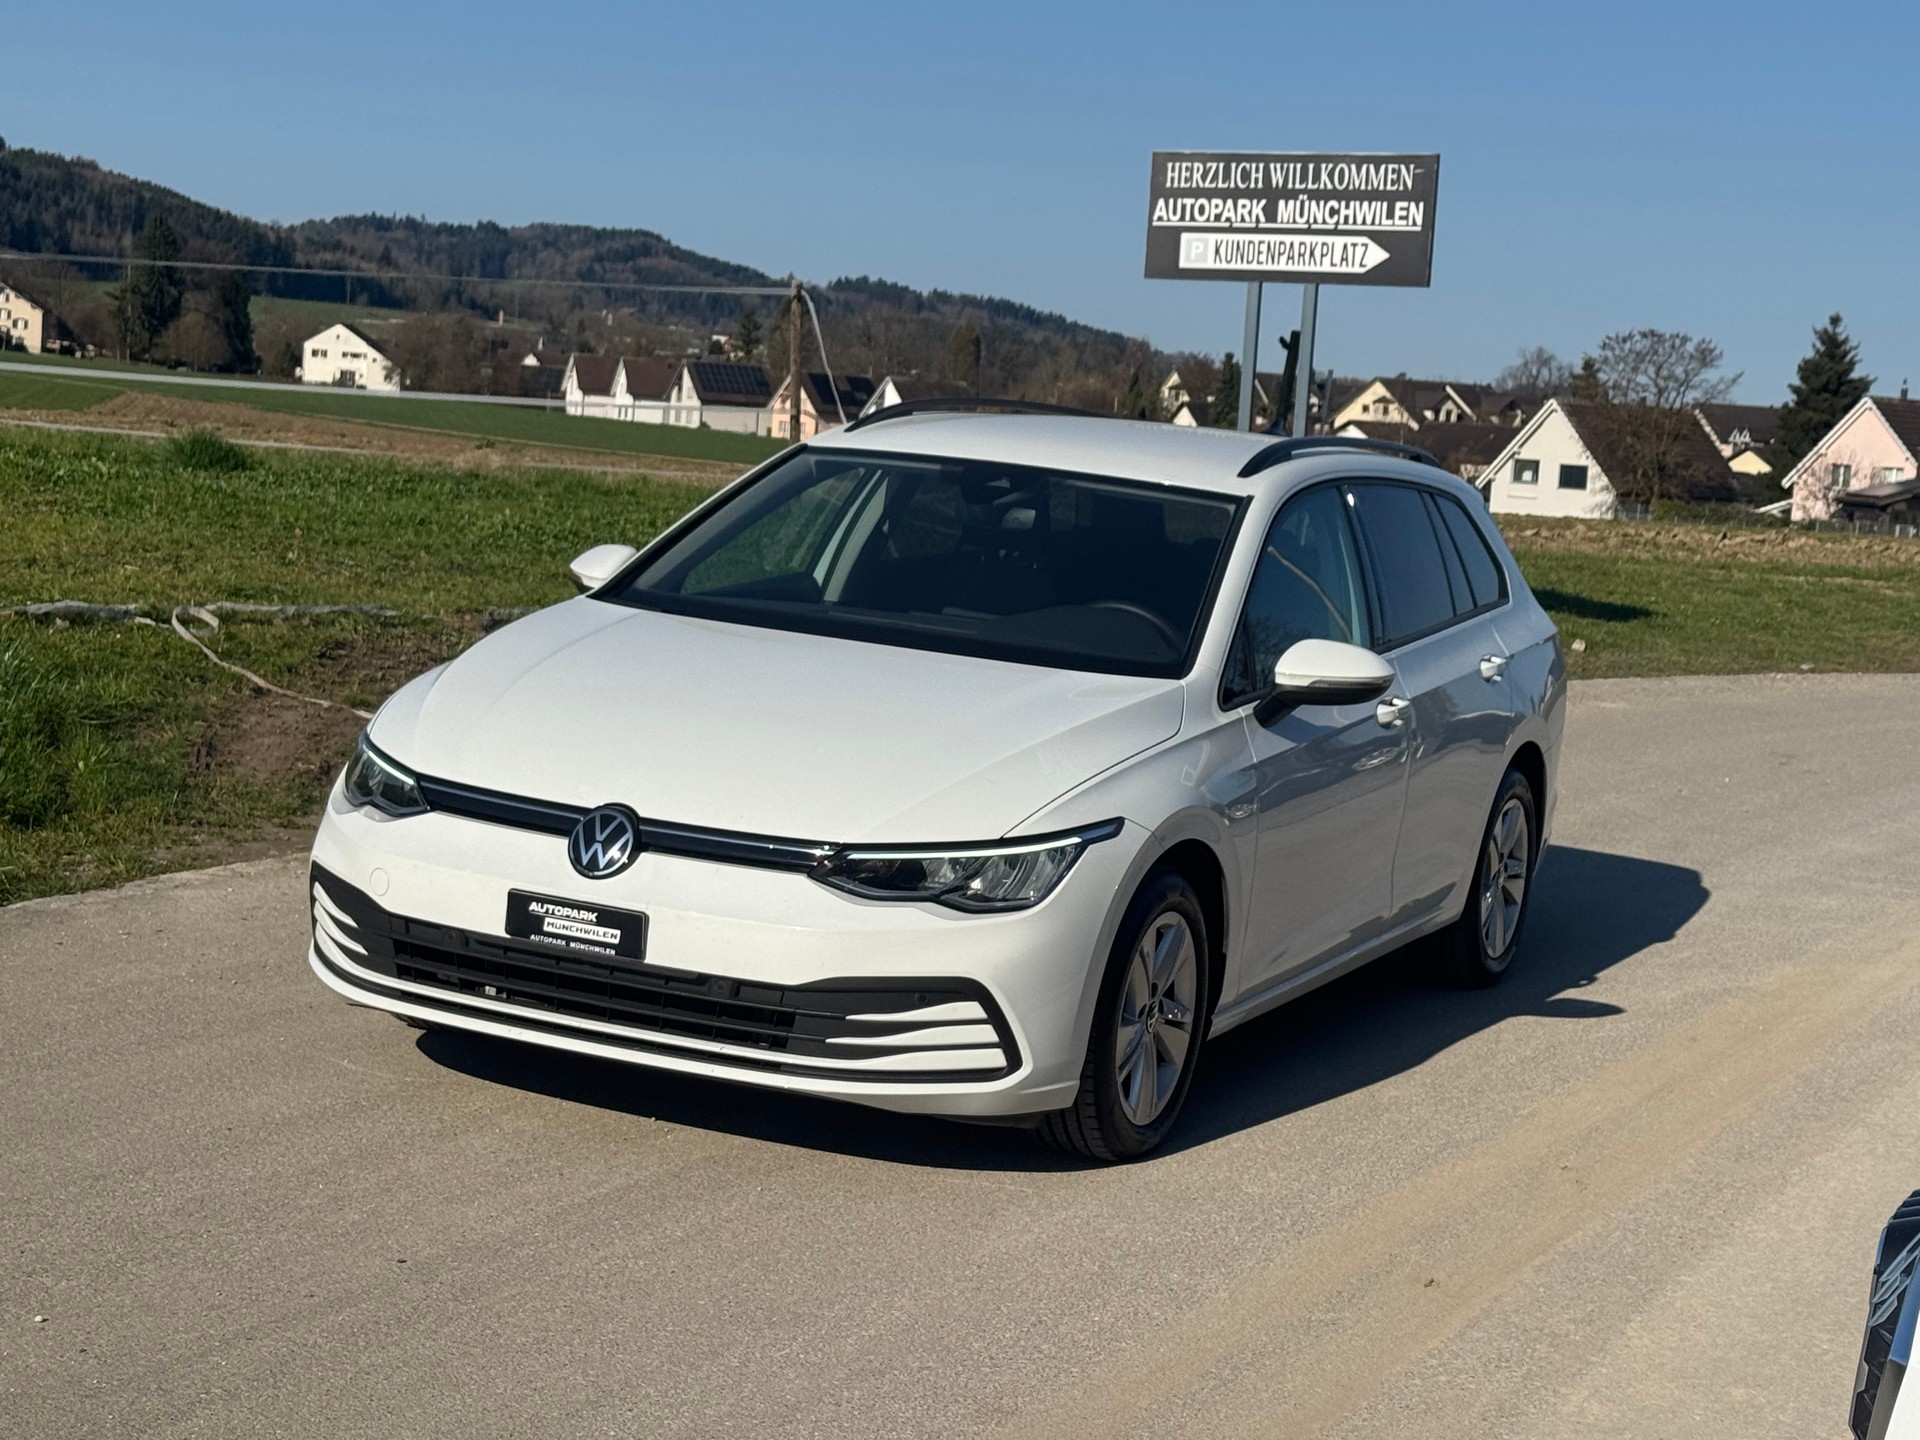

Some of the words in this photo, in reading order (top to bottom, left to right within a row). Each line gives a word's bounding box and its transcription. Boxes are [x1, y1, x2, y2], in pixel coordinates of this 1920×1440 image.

[1165, 162, 1264, 189] HERZLICH
[1269, 162, 1415, 191] WILLKOMMEN
[1153, 198, 1267, 222] AUTOPARK
[1276, 194, 1424, 226] MÜNCHWILEN
[1191, 241, 1203, 260] P
[1213, 238, 1369, 268] KUNDENPARKPLATZ
[528, 902, 598, 922] AUTOPARK
[546, 920, 618, 940] MÜNCHWILEN
[530, 934, 567, 946] AUTOPARK
[570, 942, 616, 956] MÜNCHWILEN
